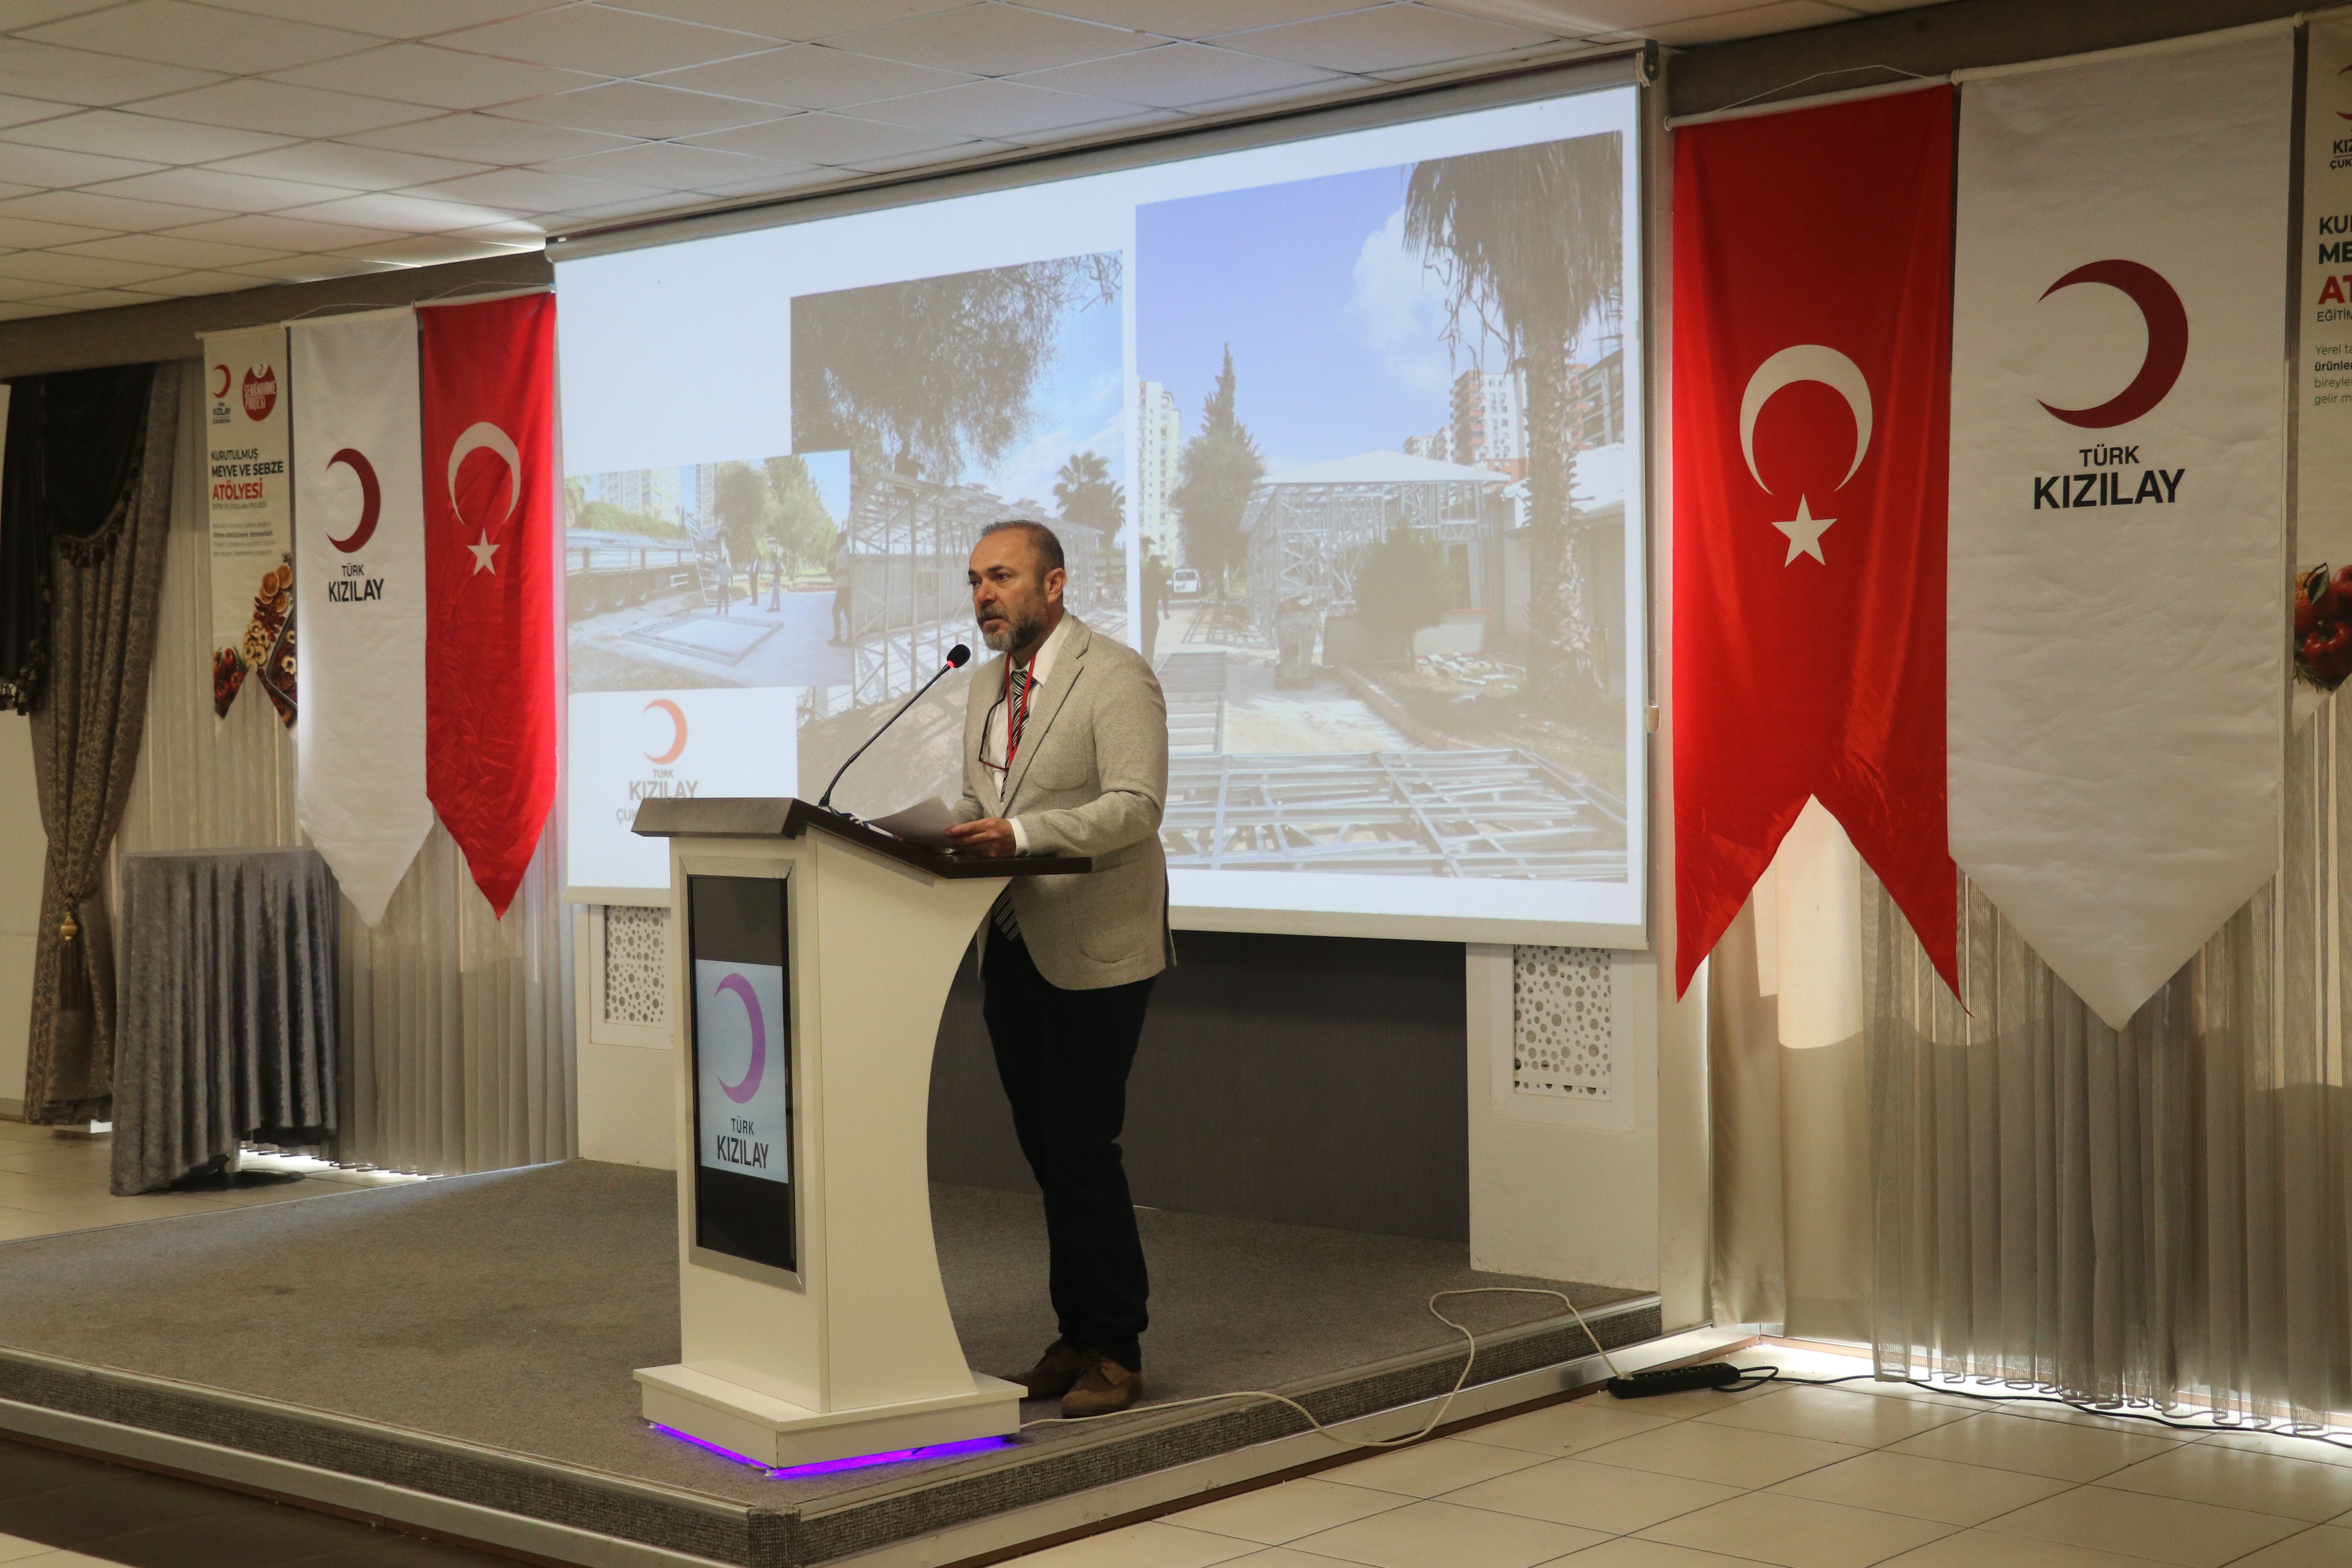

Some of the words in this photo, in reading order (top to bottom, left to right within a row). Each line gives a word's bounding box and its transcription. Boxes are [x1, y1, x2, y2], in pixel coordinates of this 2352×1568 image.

[2330, 158, 2352, 170] ÇUK
[2319, 215, 2352, 235] KU
[2315, 345, 2341, 355] Yerel
[2314, 377, 2352, 388] bireyle
[2314, 394, 2338, 405] gelir
[211, 449, 258, 461] KURUTULMUŞ
[2079, 444, 2140, 467] TÜRK
[212, 464, 238, 477] MEYVE
[239, 464, 251, 476] VE
[253, 461, 283, 475] SEBZE
[213, 477, 263, 500] ATÖLYESİ
[2034, 469, 2185, 509] KIZILAY
[342, 563, 364, 577] TÜRK
[329, 579, 384, 602] KIZILAY
[653, 768, 674, 779] TÜRK
[629, 780, 699, 800] KIZILAY
[731, 1116, 754, 1135] TÜRK
[717, 1135, 769, 1169] KIZILAY
